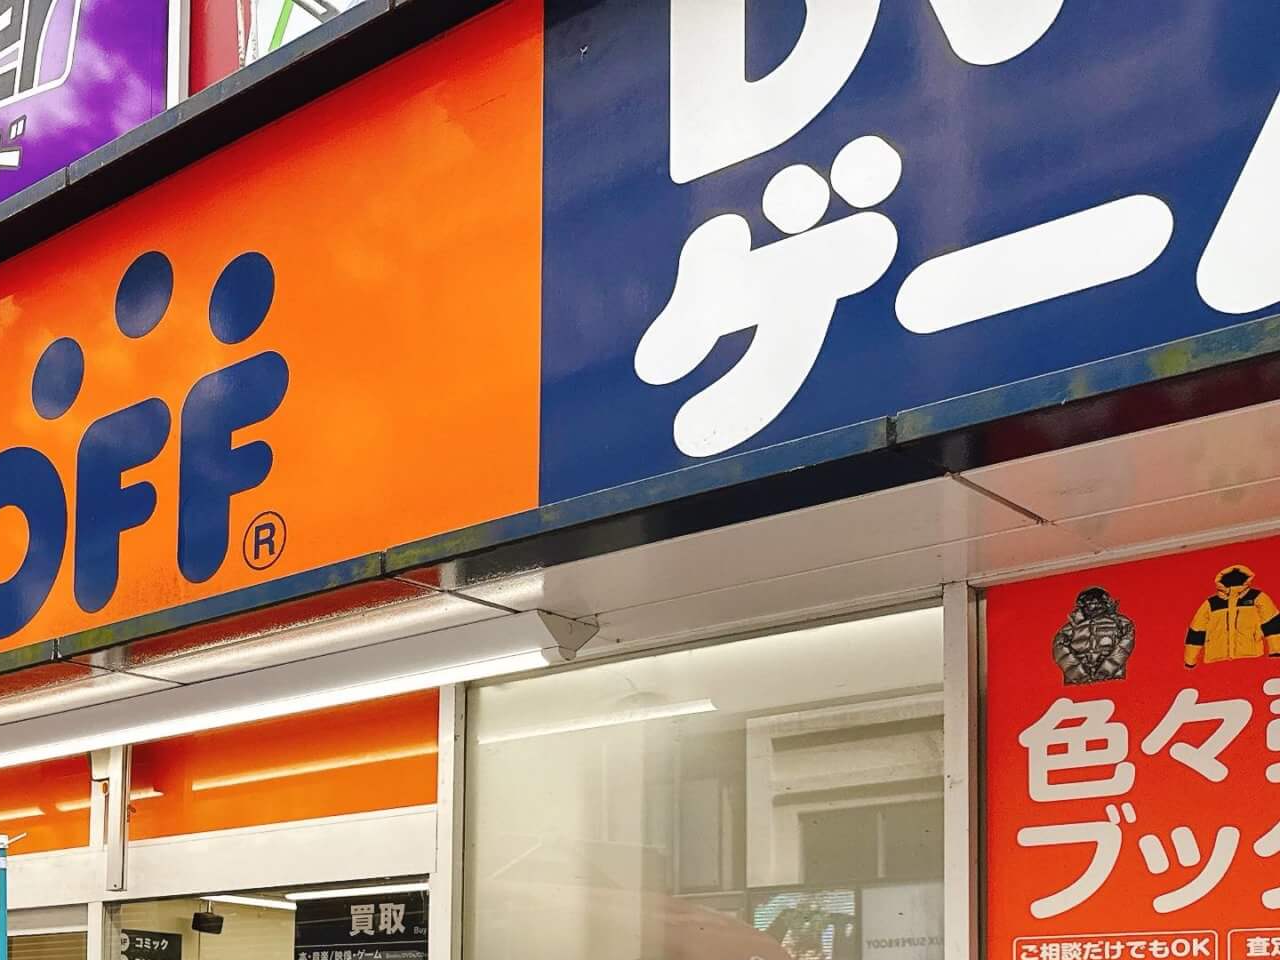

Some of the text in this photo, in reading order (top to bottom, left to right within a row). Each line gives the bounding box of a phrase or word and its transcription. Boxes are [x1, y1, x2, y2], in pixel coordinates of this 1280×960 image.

[670, 0, 1066, 185] D
[1019, 678, 1280, 802] 色々
[135, 937, 169, 950] コミック
[349, 903, 406, 936] 買取
